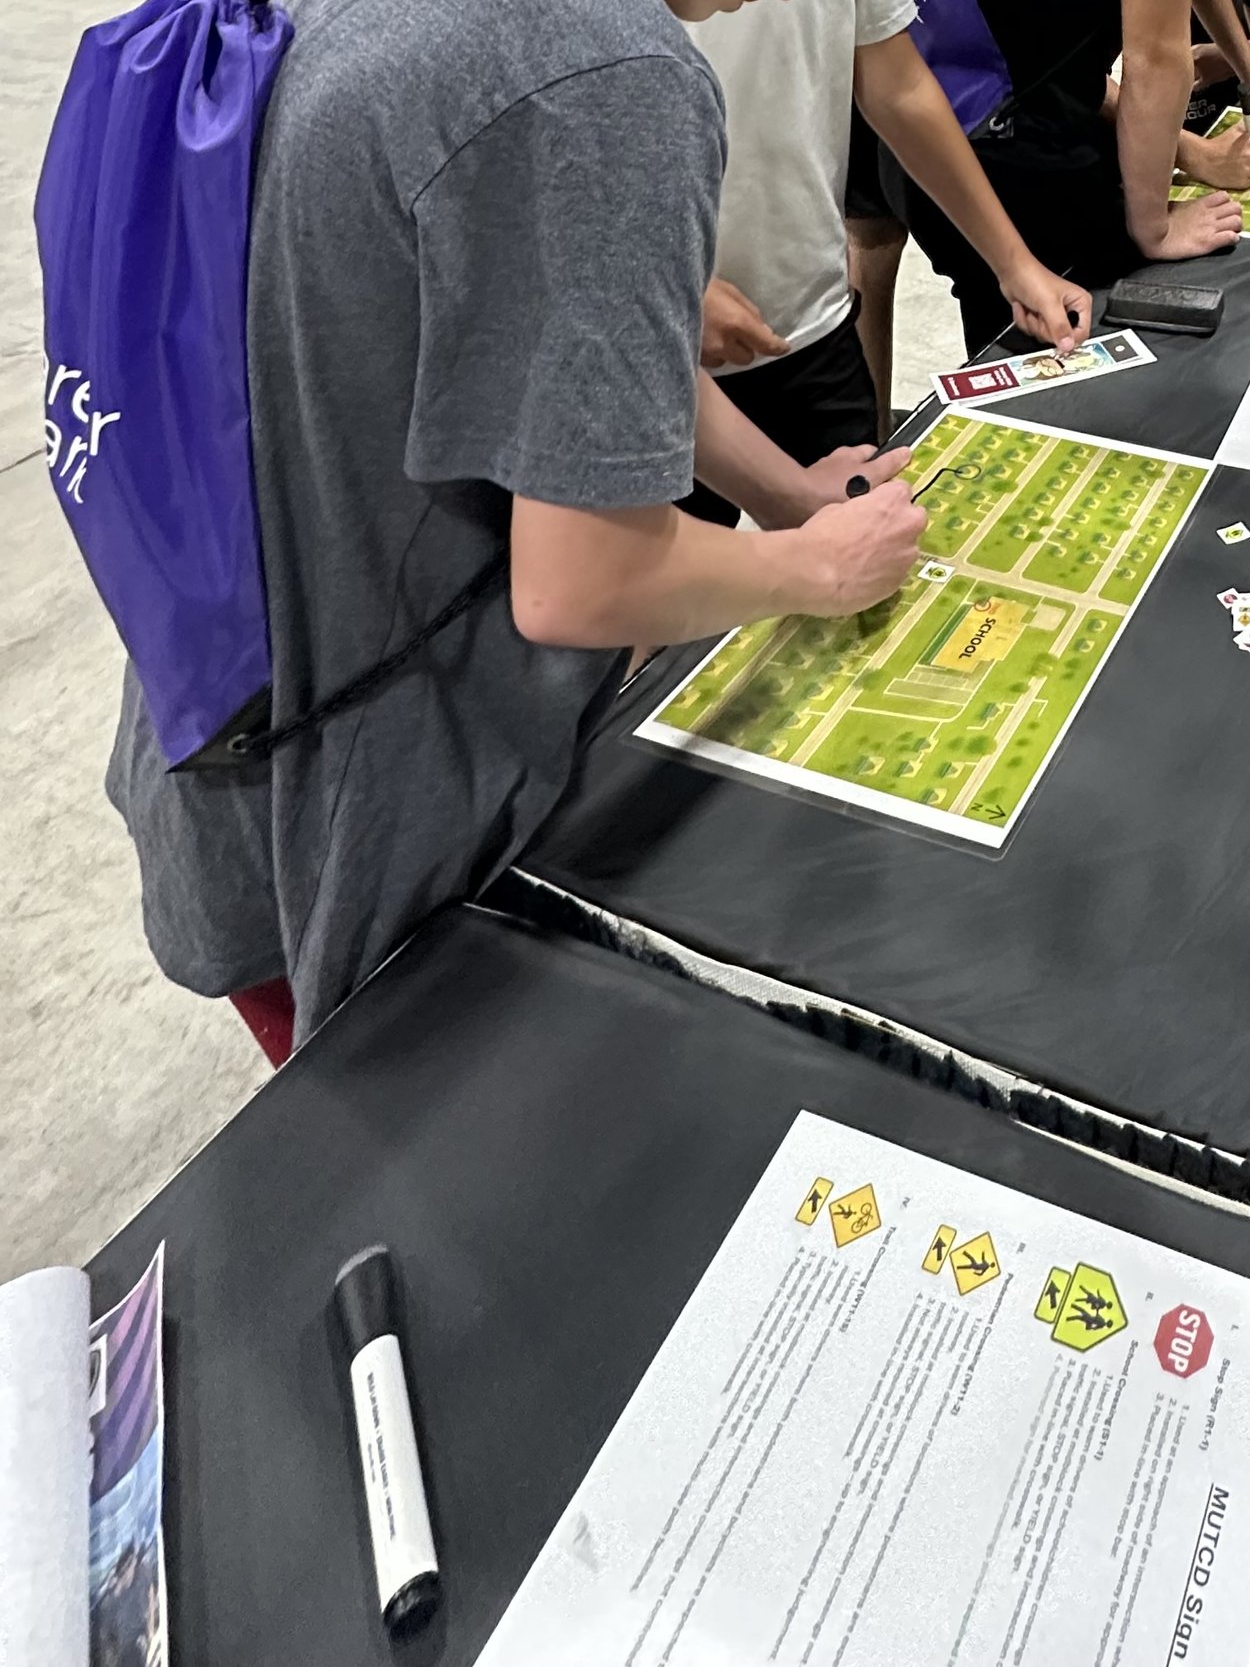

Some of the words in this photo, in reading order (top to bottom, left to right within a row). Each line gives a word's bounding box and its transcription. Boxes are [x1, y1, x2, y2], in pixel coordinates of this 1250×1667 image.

[958, 617, 997, 659] SCHOOL
[971, 802, 983, 812] N
[882, 1227, 896, 1245] Trail
[779, 1257, 800, 1288] Placed
[860, 1246, 886, 1288] Crossing
[988, 1273, 1014, 1324] Pedestrian
[781, 1315, 796, 1343] STOP
[828, 1304, 843, 1327] warn
[896, 1303, 919, 1345] Installed
[918, 1309, 931, 1326] Not
[931, 1302, 946, 1329] traffic
[751, 1321, 764, 1341] with
[811, 1328, 830, 1362] drivers
[902, 1327, 920, 1361] always
[931, 1318, 954, 1361] Installed
[1166, 1308, 1202, 1374] STOP
[958, 1352, 967, 1363] to
[967, 1326, 992, 1372] Crossing
[1122, 1340, 1138, 1376] School
[760, 1369, 767, 1381] or
[794, 1364, 813, 1395] where
[905, 1365, 919, 1394] STOP
[926, 1361, 933, 1372] at
[948, 1364, 961, 1390] warn
[1073, 1364, 1088, 1393] traffic
[1217, 1358, 1230, 1384] Stop
[742, 1383, 762, 1413] YIELD
[752, 1371, 780, 1420] crossings
[870, 1383, 882, 1402] with
[883, 1363, 905, 1406] required
[951, 1374, 972, 1416] (W11-2)
[1055, 1370, 1072, 1407] Placed
[1210, 1386, 1223, 1412] Sign
[781, 1397, 798, 1422] both
[877, 1408, 884, 1419] at
[932, 1391, 950, 1427] drivers
[1077, 1381, 1097, 1427] Installed
[1104, 1378, 1126, 1426] Crossing
[886, 1422, 893, 1434] or
[1030, 1415, 1040, 1437] sign
[1042, 1408, 1058, 1442] in-line
[1092, 1412, 1101, 1424] to
[1144, 1405, 1161, 1442] Placed
[1173, 1416, 1186, 1445] Used
[1199, 1415, 1215, 1450] (R1-1)
[708, 1426, 723, 1449] with
[740, 1422, 754, 1444] and
[852, 1420, 879, 1472] crossings
[927, 1428, 934, 1442] of
[1072, 1428, 1080, 1439] at
[1083, 1425, 1095, 1452] warn
[1094, 1428, 1110, 1461] (S1-1)
[1154, 1411, 1173, 1458] Installed
[747, 1422, 783, 1489] pedestrians
[870, 1436, 889, 1469] YIELD
[881, 1423, 907, 1476] crossings
[1034, 1444, 1045, 1467] with
[1052, 1434, 1065, 1463] STOP
[1134, 1443, 1149, 1479] in-line
[1169, 1446, 1176, 1457] at
[1055, 1441, 1076, 1493] midblock
[1070, 1454, 1086, 1493] drivers
[1151, 1459, 1158, 1474] on
[1166, 1458, 1173, 1473] an
[735, 1491, 749, 1515] and
[841, 1483, 851, 1499] up
[871, 1478, 883, 1501] and
[1036, 1493, 1043, 1507] or
[1065, 1495, 1073, 1508] of
[1126, 1481, 1137, 1505] with
[1142, 1476, 1153, 1502] right
[1150, 1475, 1168, 1531] approach
[662, 1507, 679, 1536] path
[835, 1501, 845, 1513] to
[888, 1497, 907, 1533] where
[1117, 1507, 1129, 1534] stop
[1134, 1503, 1146, 1529] side
[1023, 1509, 1040, 1544] YIELD
[1035, 1495, 1057, 1552] crossings
[1131, 1531, 1138, 1545] of
[1194, 1485, 1229, 1587] MUTCD
[673, 1515, 706, 1573] crossings
[705, 1516, 738, 1573] bicyclists
[801, 1515, 837, 1587] engineering
[839, 1503, 874, 1575] intersection
[1145, 1533, 1152, 1547] of
[1026, 1555, 1038, 1580] and
[1035, 1509, 1069, 1602] schoolchildren
[1141, 1548, 1148, 1564] an
[694, 1575, 706, 1596] are
[857, 1534, 891, 1609] pedestrians
[1114, 1546, 1134, 1600] roadway
[661, 1575, 675, 1598] not
[812, 1577, 841, 1640] crossings
[1109, 1602, 1119, 1620] for
[1118, 1566, 1145, 1643] intersection
[662, 1598, 696, 1662] expected
[848, 1611, 859, 1633] are
[951, 1598, 976, 1658] required
[1000, 1581, 1031, 1659] intersection
[1170, 1592, 1202, 1659] Sign
